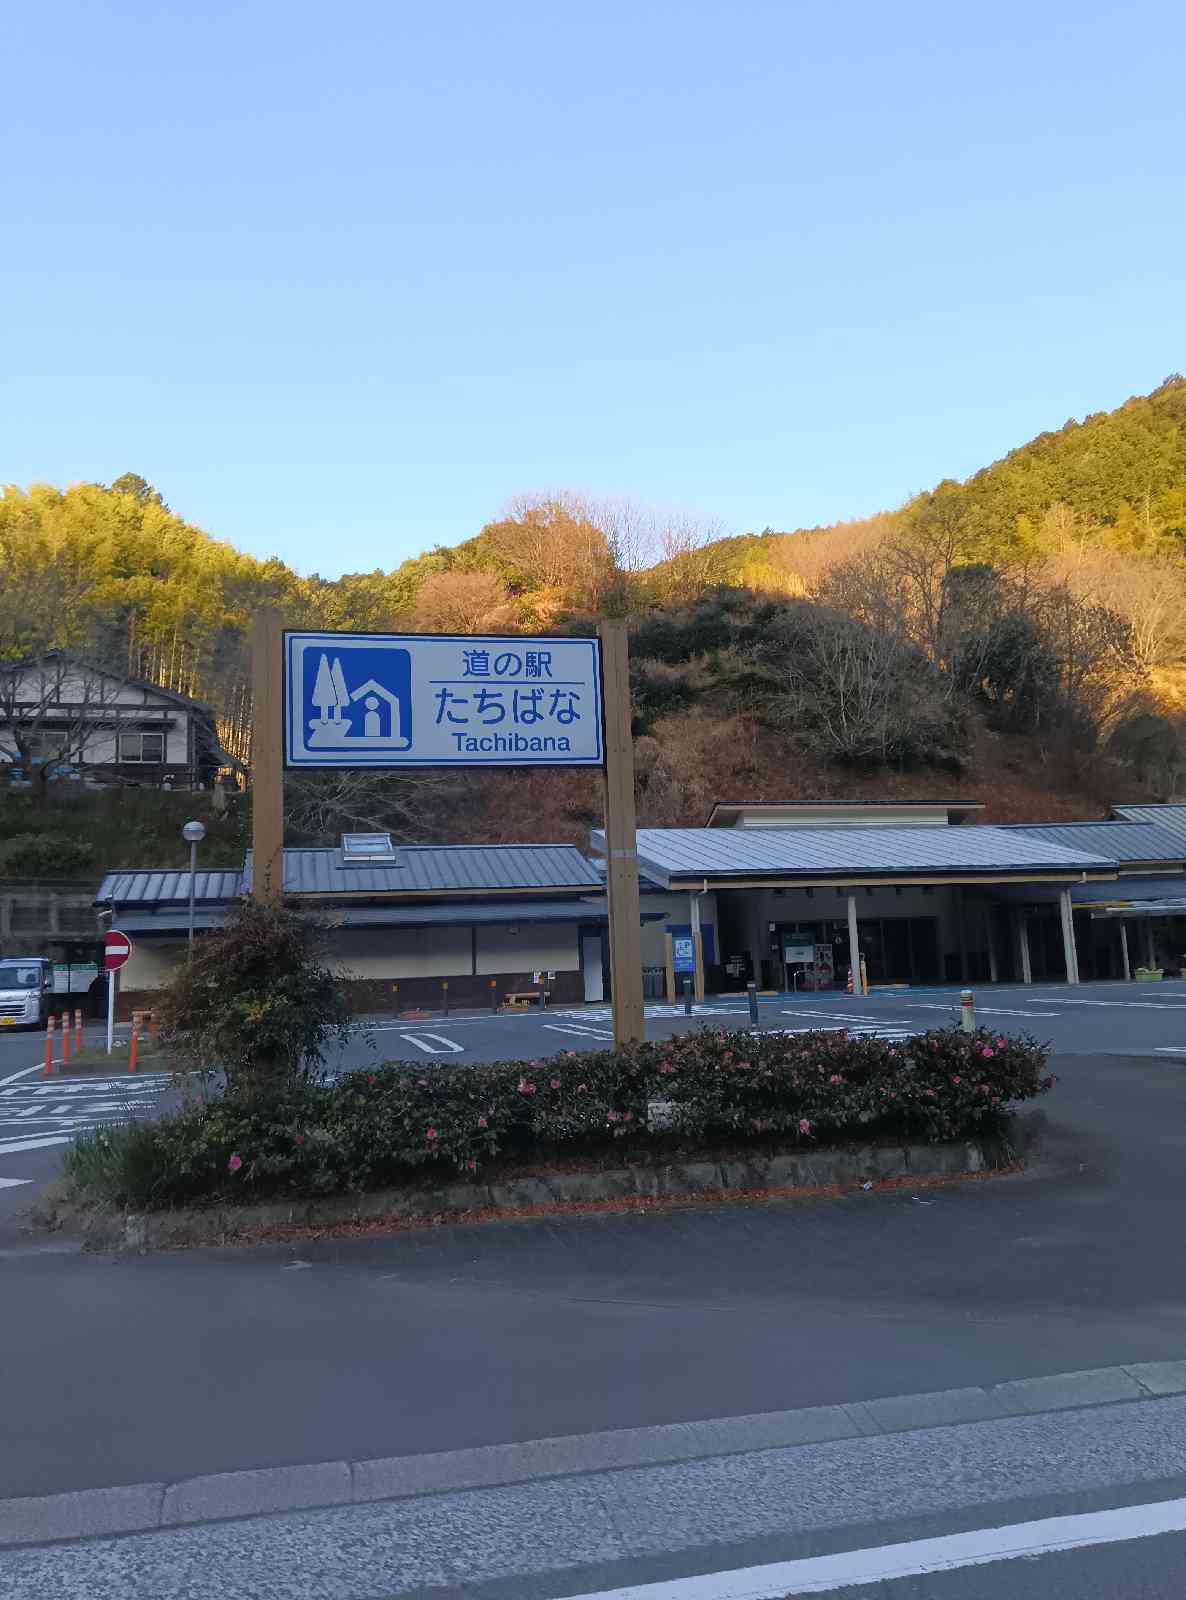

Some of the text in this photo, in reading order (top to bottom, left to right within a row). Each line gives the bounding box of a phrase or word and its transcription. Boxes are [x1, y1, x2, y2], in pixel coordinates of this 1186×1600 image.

[462, 649, 552, 678] 道の駅
[434, 687, 581, 725] たちばな
[452, 732, 571, 753] Tachibana
